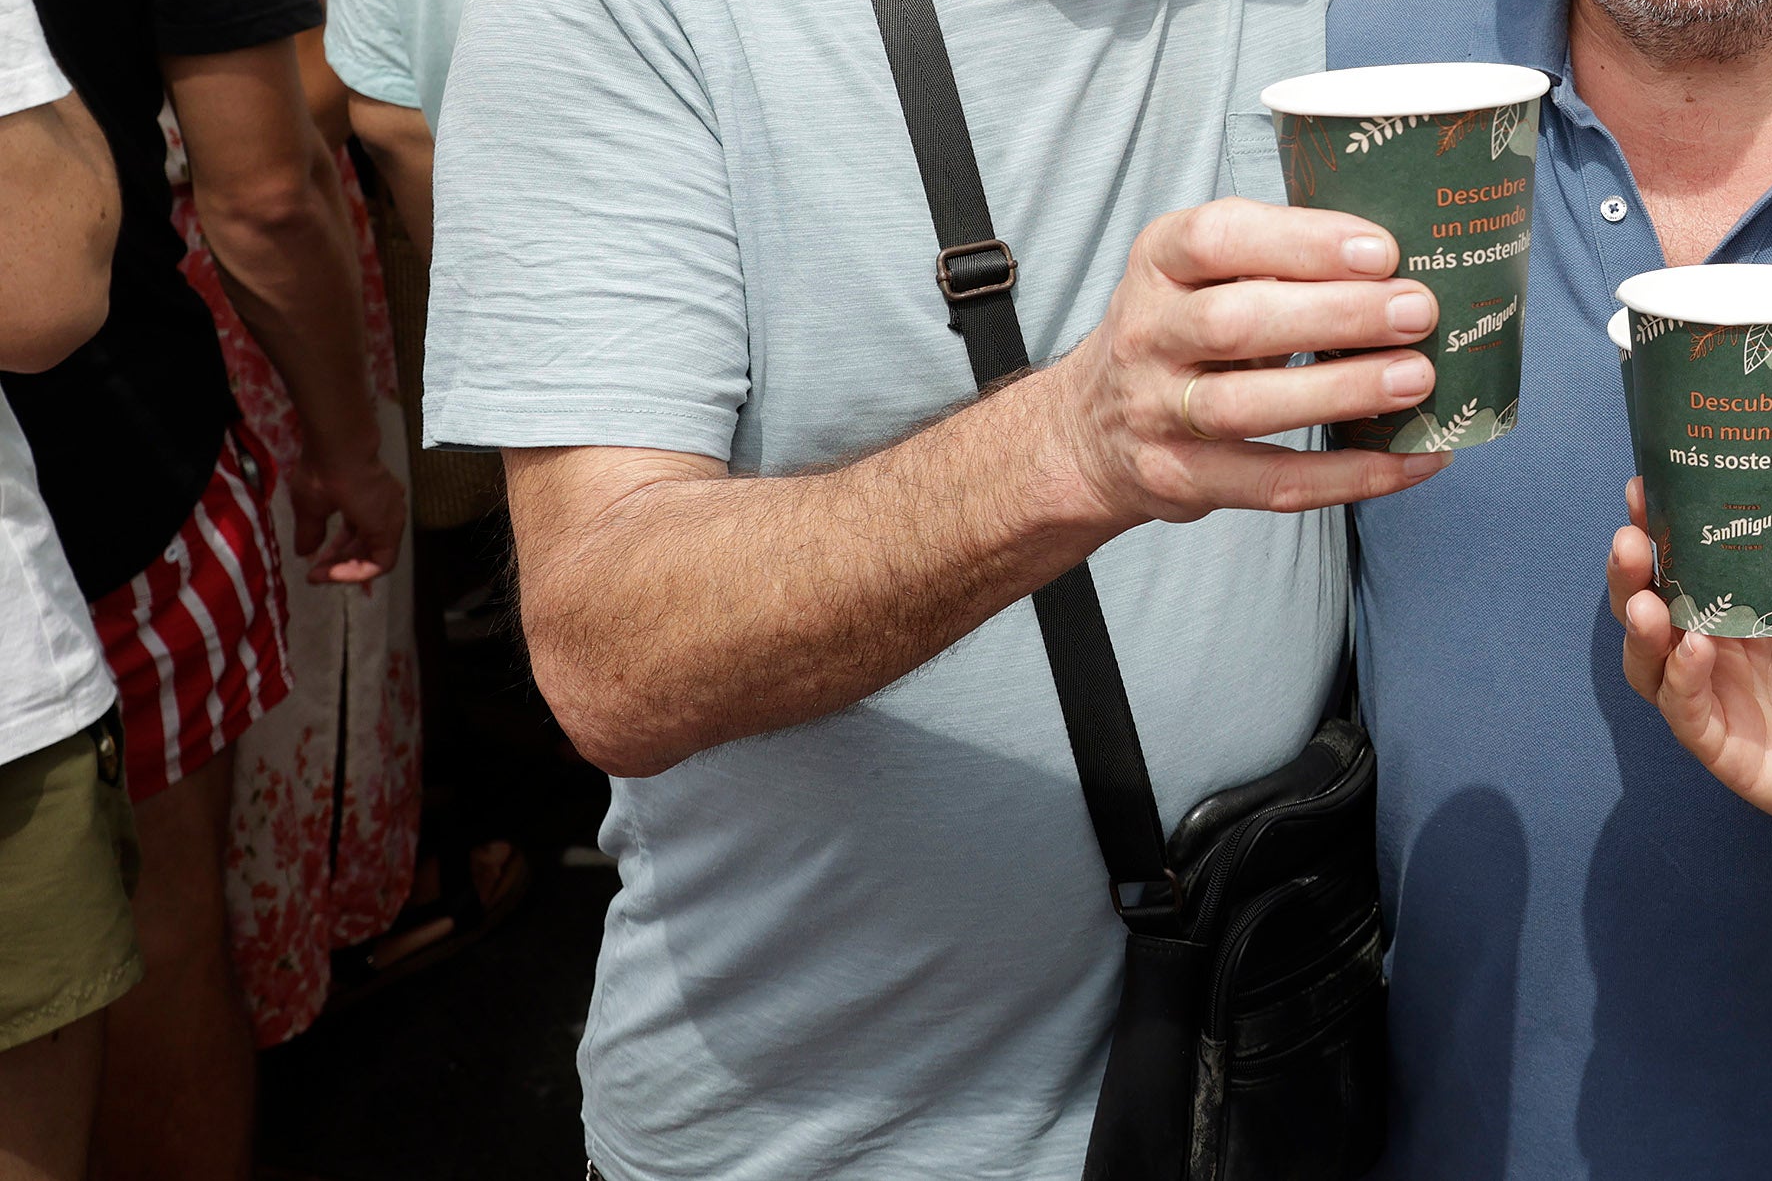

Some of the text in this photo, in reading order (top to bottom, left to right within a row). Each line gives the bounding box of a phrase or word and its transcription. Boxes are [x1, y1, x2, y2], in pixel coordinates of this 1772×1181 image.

[1436, 178, 1526, 207] Descubre
[1432, 205, 1526, 238] un mundo
[1408, 229, 1531, 271] más sostenibl
[1445, 294, 1518, 352] SanMiguel
[1687, 423, 1713, 439] un
[1669, 446, 1709, 467] más
